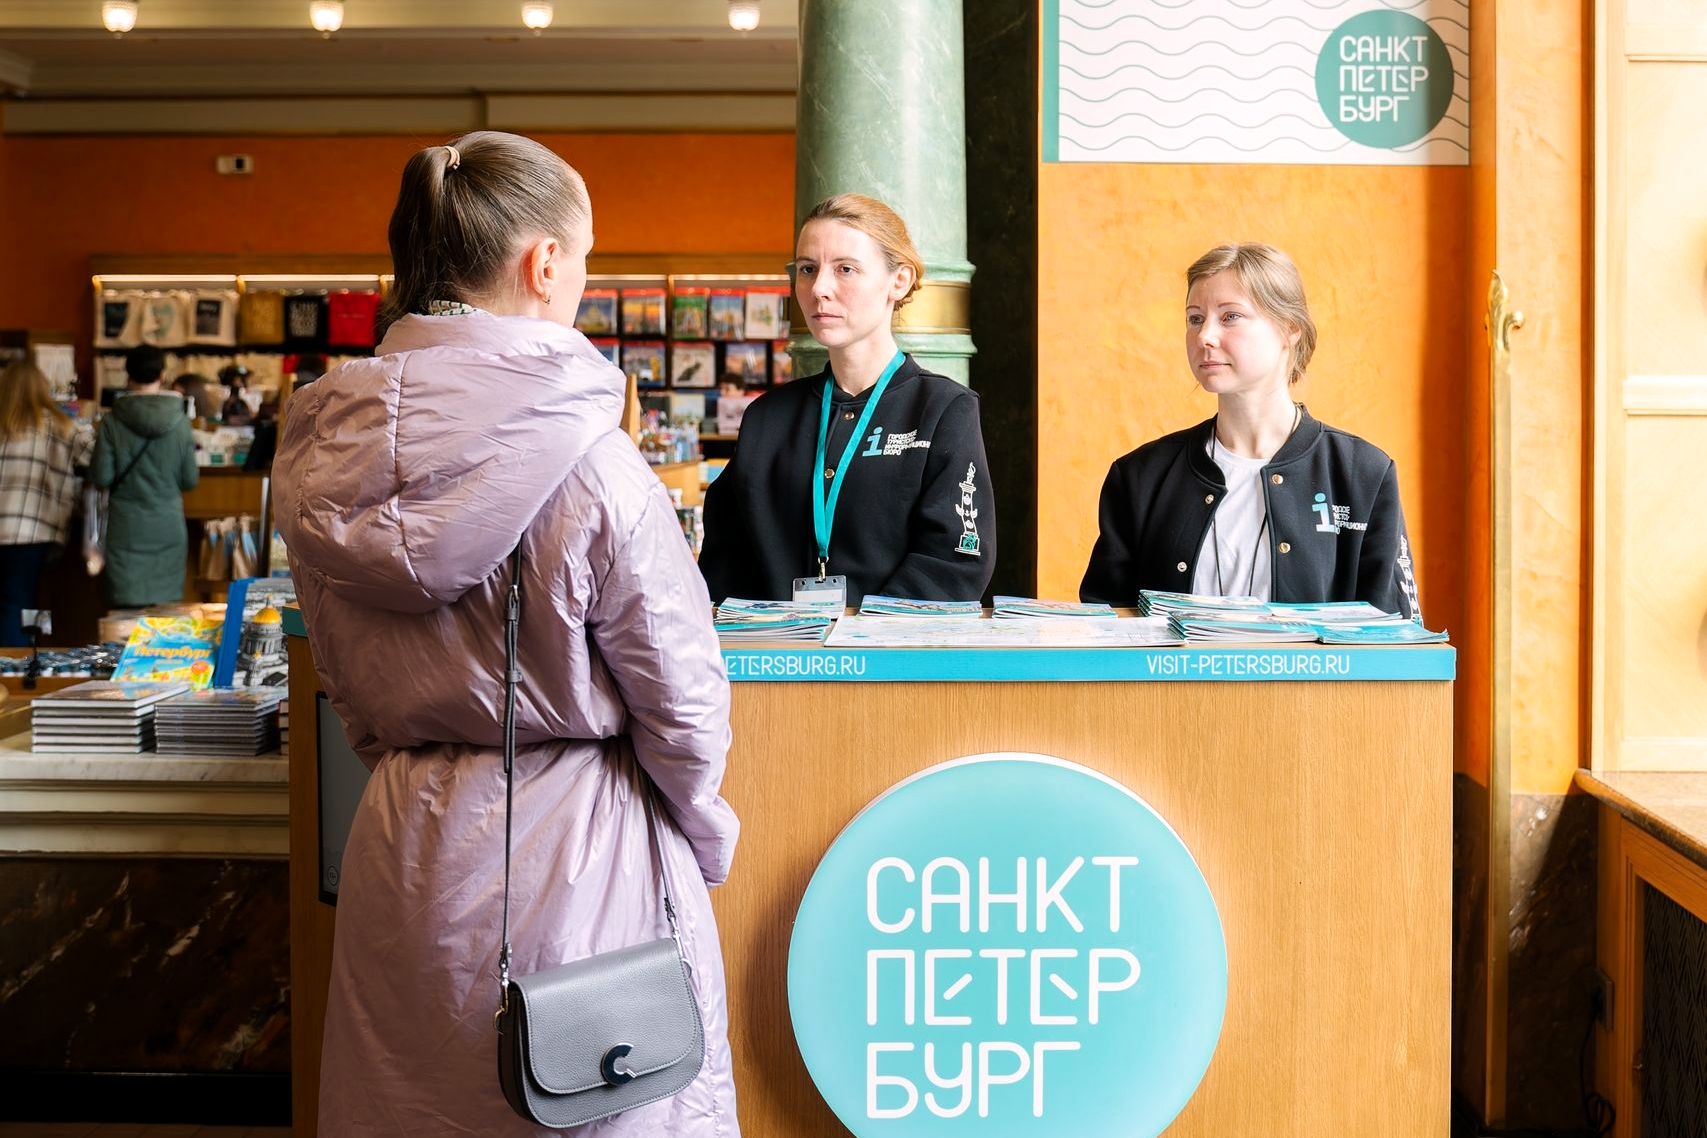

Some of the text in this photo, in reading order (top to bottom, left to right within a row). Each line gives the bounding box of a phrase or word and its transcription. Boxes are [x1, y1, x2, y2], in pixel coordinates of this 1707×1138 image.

[1339, 35, 1428, 62] САНКТ
[1339, 65, 1429, 92] ПЕТЕР
[1339, 95, 1410, 122] БУРГ
[721, 655, 866, 675] ETERSBURG.RU
[1146, 654, 1350, 675] VISIT-PETERSBURG.RU
[867, 856, 1139, 933] САНКТ
[867, 948, 1141, 1025] ПЕТЕР
[867, 1041, 1081, 1119] БУРГ
